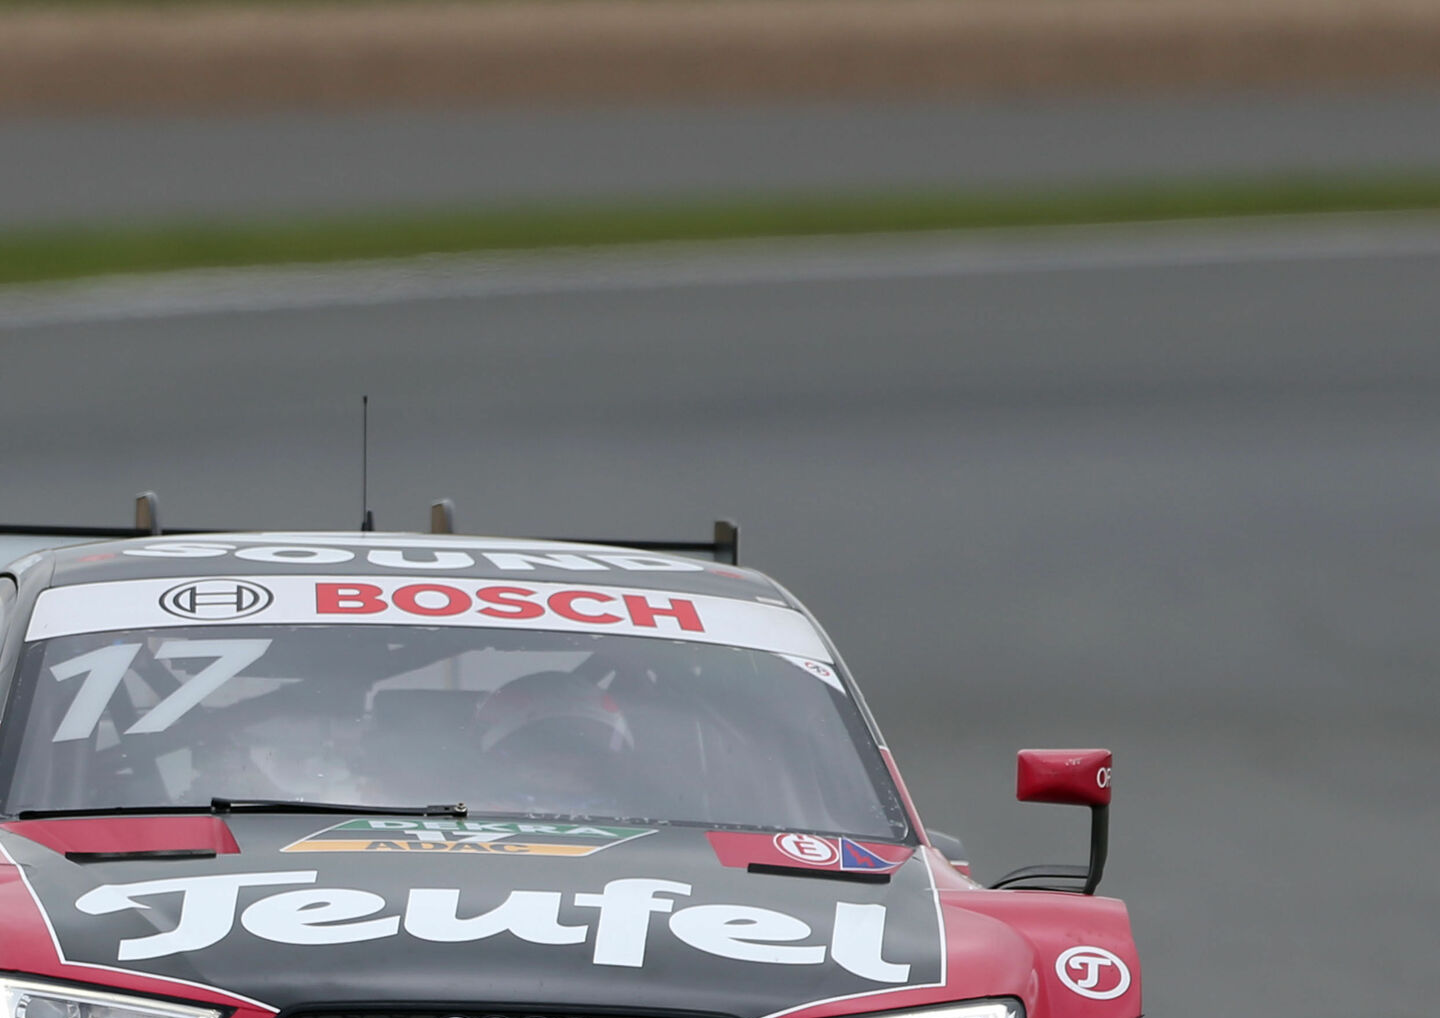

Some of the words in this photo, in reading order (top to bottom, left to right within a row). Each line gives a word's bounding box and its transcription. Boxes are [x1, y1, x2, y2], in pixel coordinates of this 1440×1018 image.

[122, 543, 705, 571] SOUND
[314, 582, 706, 633] BOSCH
[49, 638, 273, 743] 17
[364, 840, 532, 853] ADAC
[367, 819, 620, 838] DEKRA
[74, 870, 911, 984] Teufel
